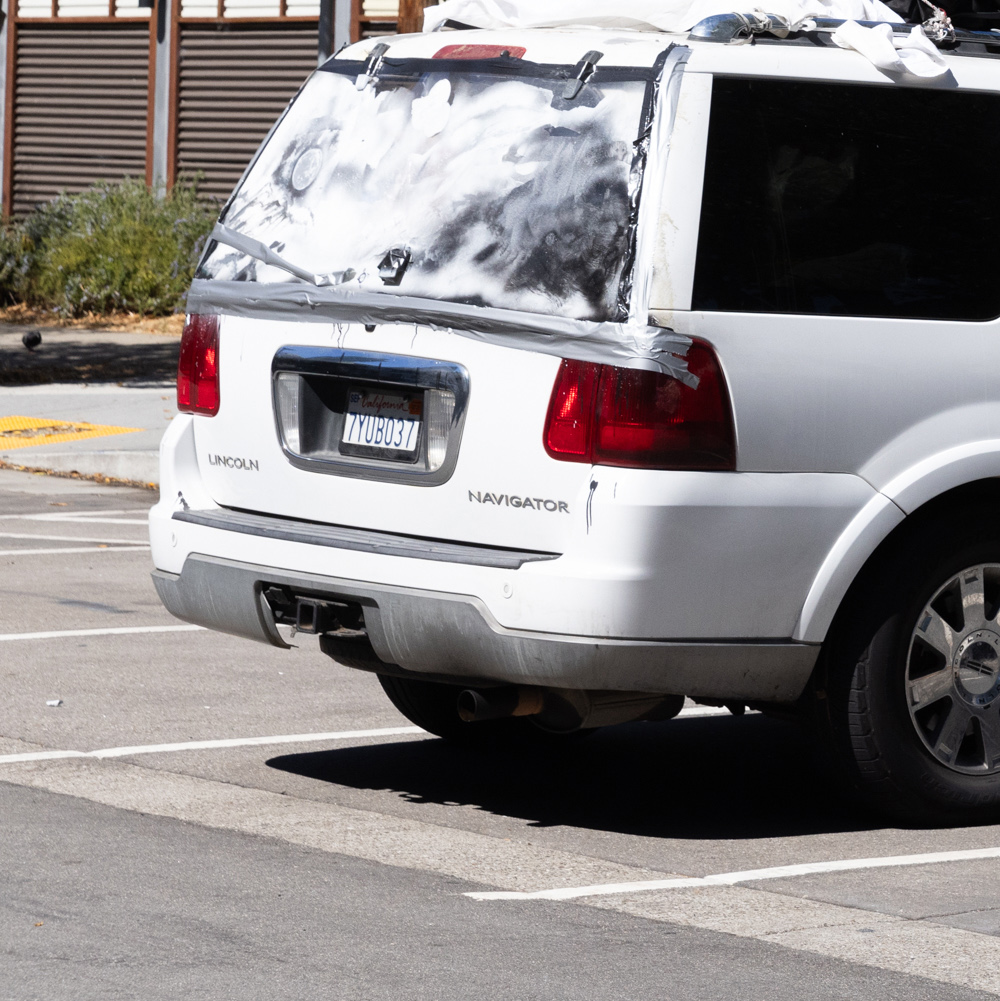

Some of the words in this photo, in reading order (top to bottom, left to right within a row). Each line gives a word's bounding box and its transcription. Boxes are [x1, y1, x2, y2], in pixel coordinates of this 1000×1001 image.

[348, 411, 415, 449] 7YUB037
[208, 453, 259, 472] LINCOLN
[468, 490, 570, 513] NAVIGATOR
